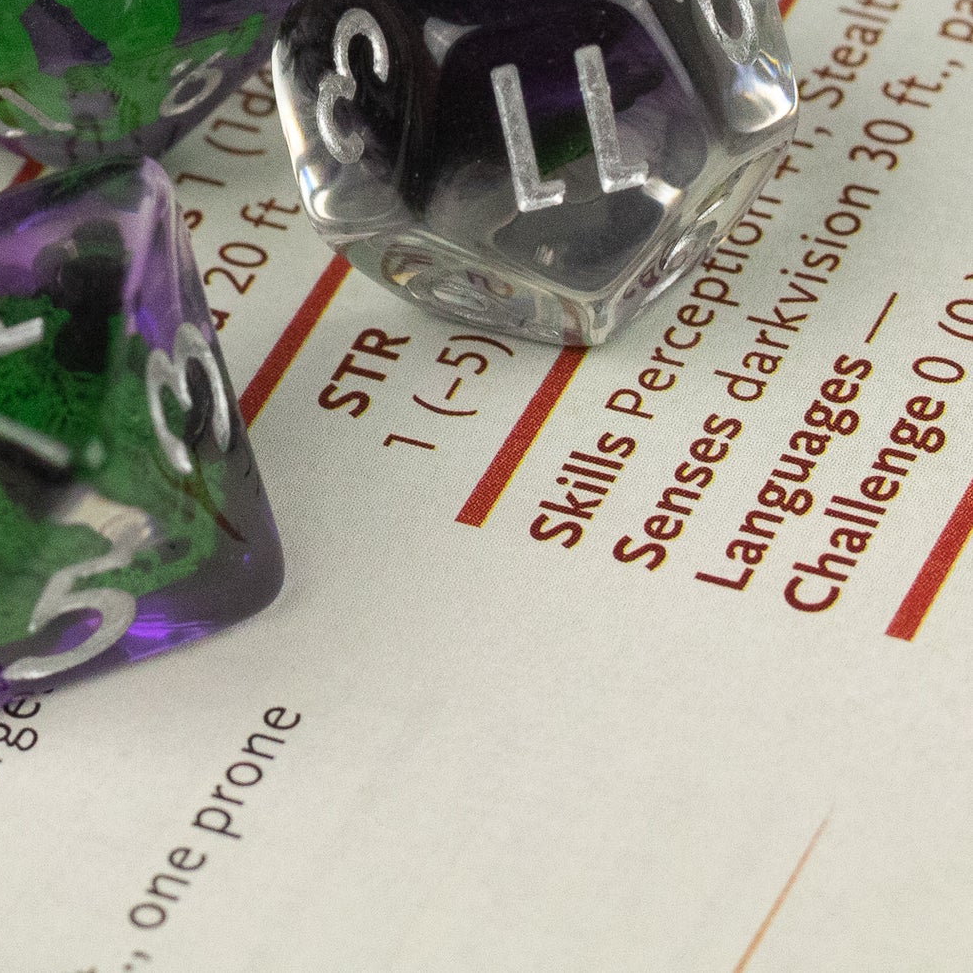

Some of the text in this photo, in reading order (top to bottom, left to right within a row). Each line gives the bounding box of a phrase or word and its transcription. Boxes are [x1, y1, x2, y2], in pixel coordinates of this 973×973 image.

[315, 7, 390, 164] 3
[202, 241, 269, 295] 20
[611, 412, 745, 572] Senses
[714, 181, 880, 403] darkvision
[848, 118, 917, 171] 30
[144, 323, 231, 475] 3
[317, 327, 412, 420] STR
[381, 432, 438, 452] 1
[528, 431, 640, 550] Skills
[604, 192, 783, 421] Perception
[694, 352, 874, 592] Languages
[783, 394, 948, 614] Challenge
[911, 355, 966, 385] 0
[0, 507, 137, 682] 5
[129, 705, 303, 930] one prone
